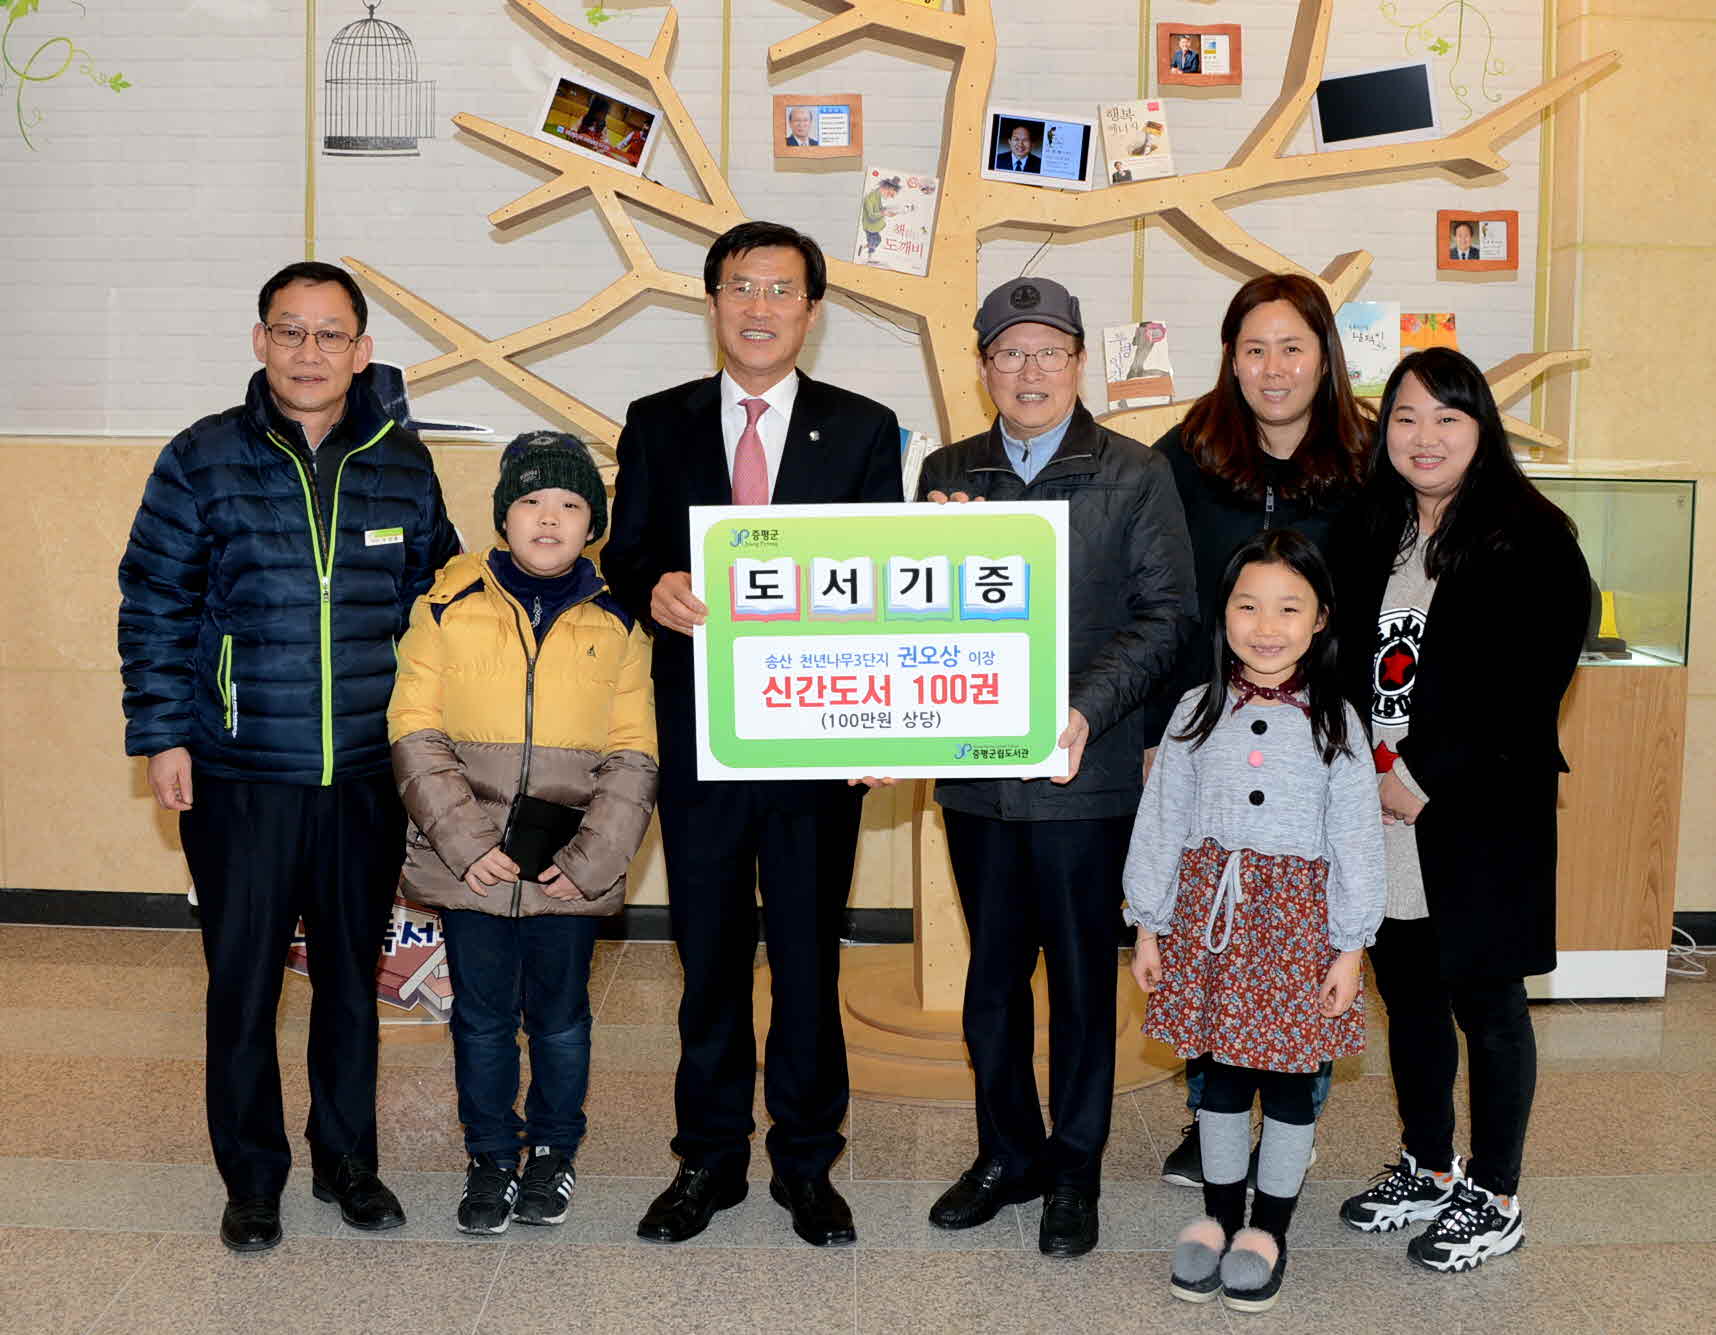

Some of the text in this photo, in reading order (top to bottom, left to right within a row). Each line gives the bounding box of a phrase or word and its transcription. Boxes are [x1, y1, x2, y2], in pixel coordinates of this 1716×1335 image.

[751, 529, 779, 541] 증평군
[764, 645, 996, 670] 송산 천년나무3단지 권오상 이장
[762, 672, 999, 708] 신간도서 100권
[821, 711, 942, 729] (100만원 상당)
